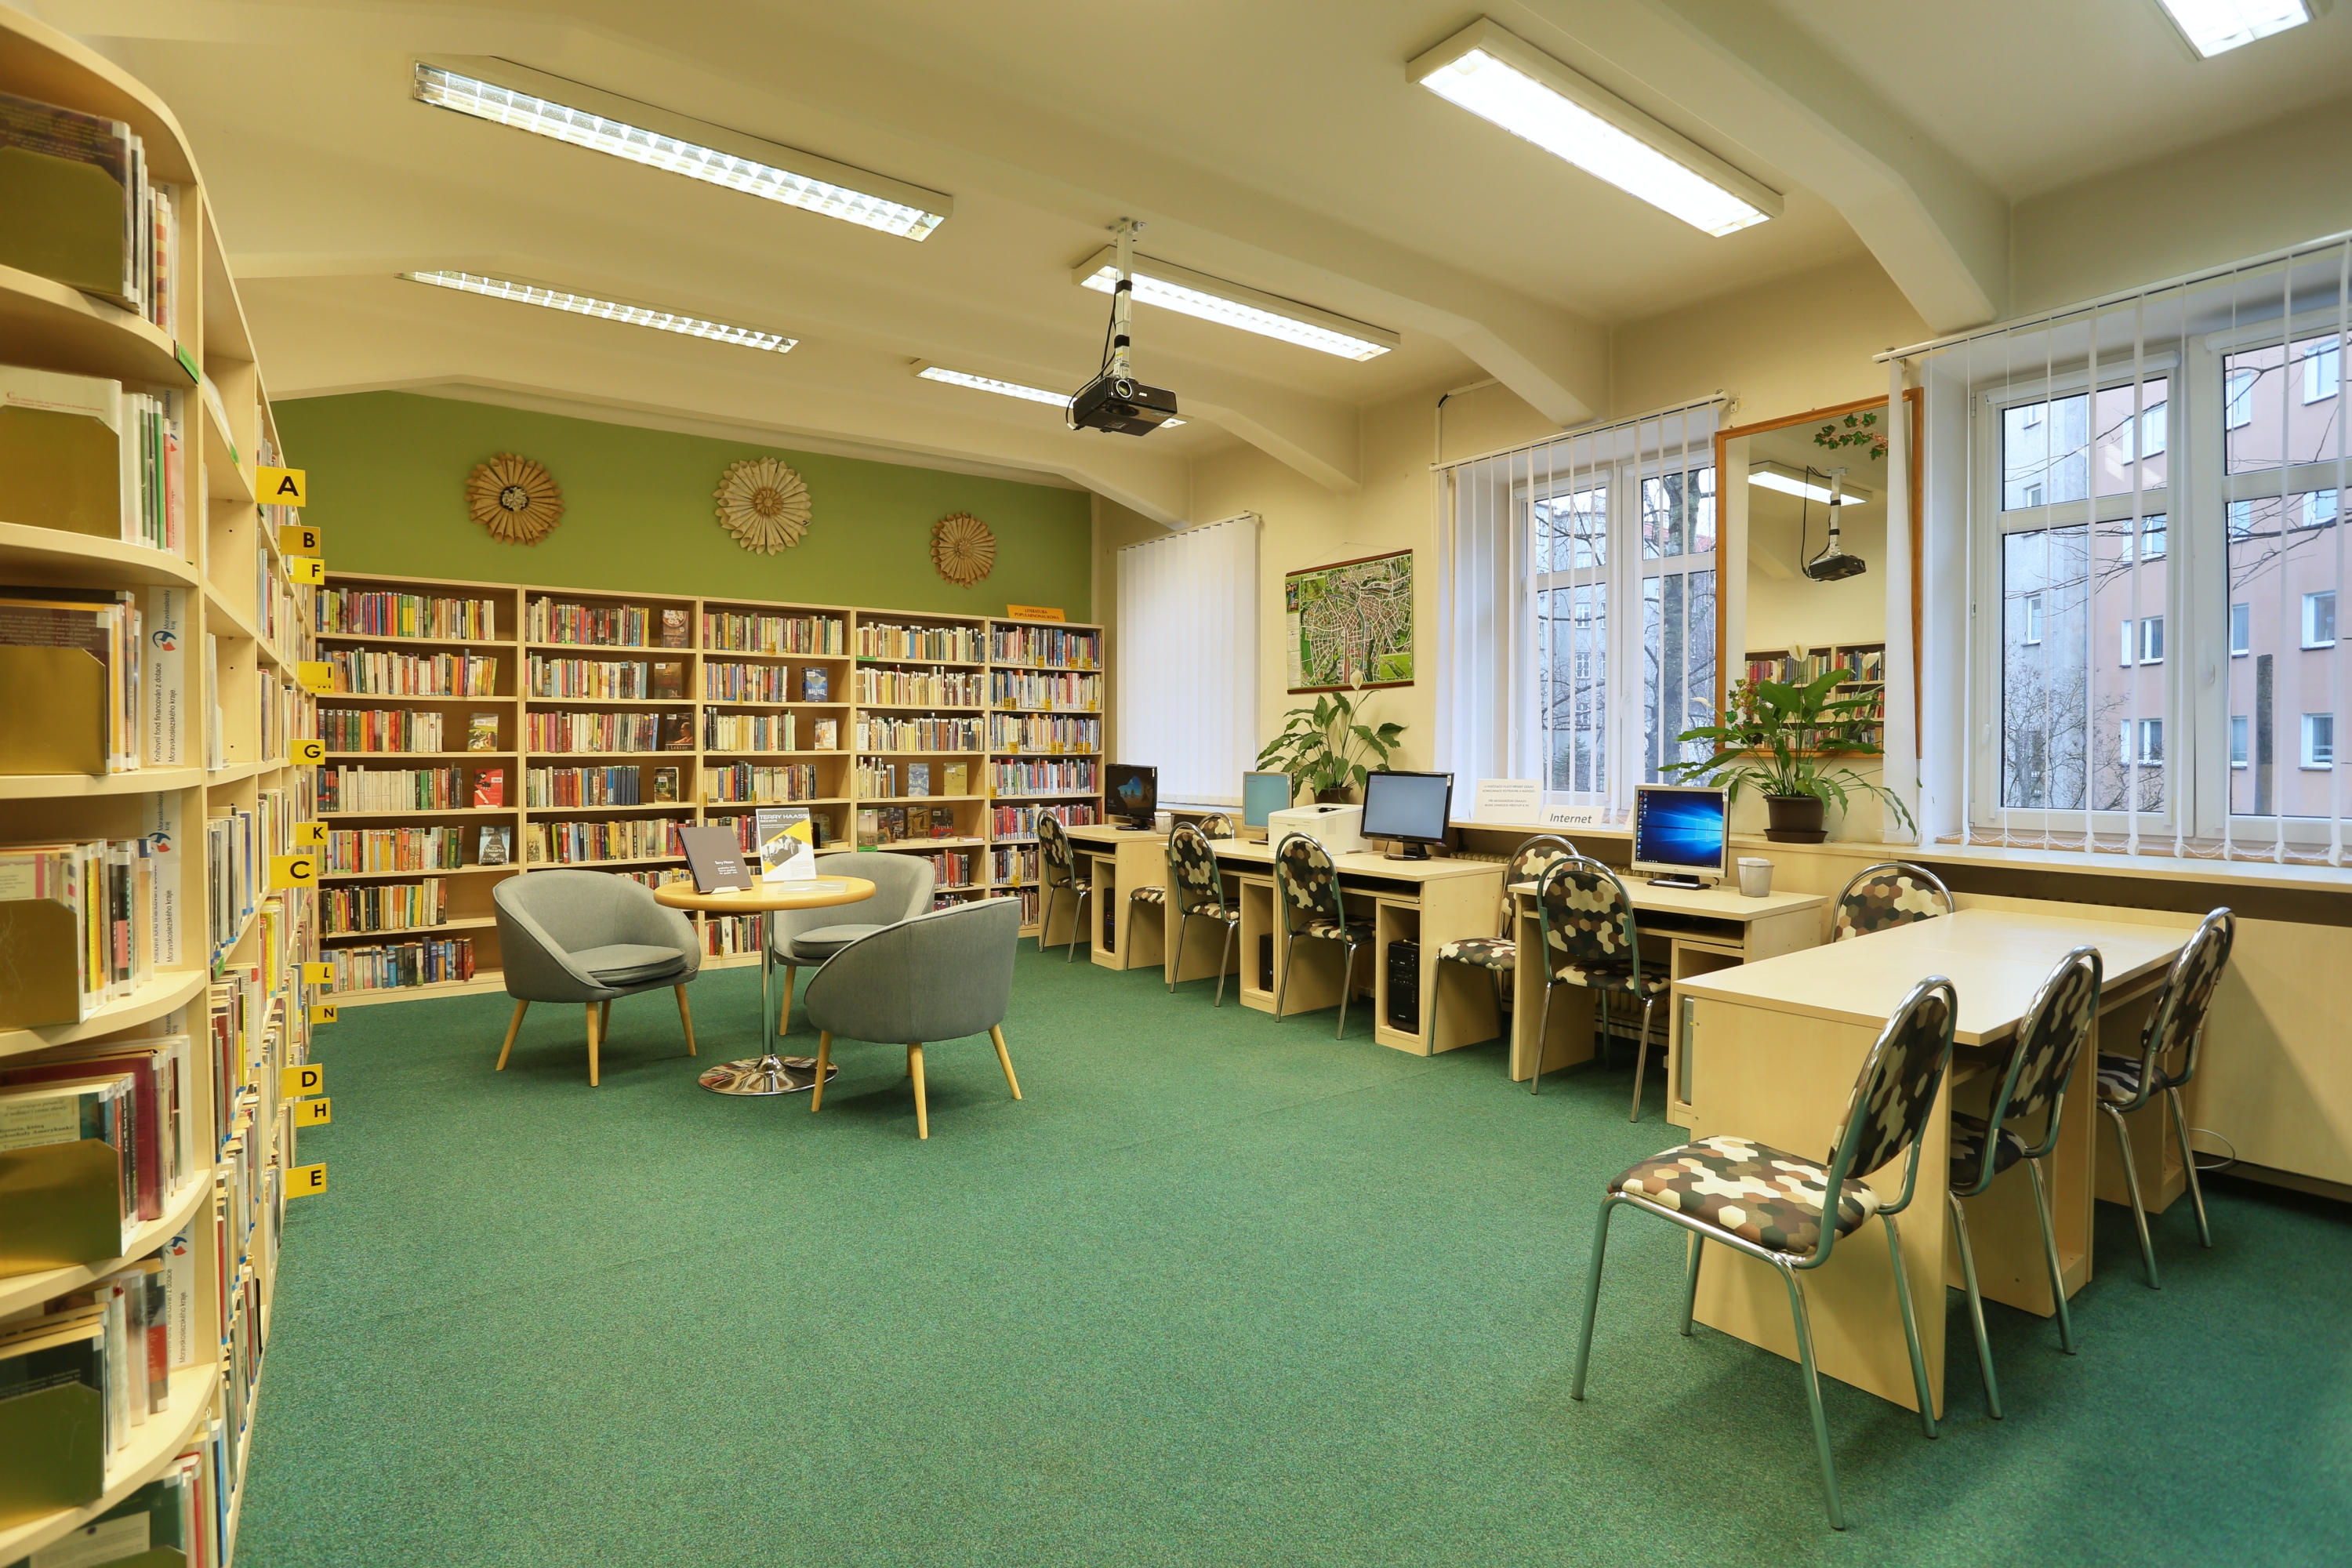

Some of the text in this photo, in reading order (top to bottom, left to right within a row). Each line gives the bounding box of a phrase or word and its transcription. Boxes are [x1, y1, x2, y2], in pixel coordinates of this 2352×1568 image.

[277, 475, 299, 497] A
[303, 532, 316, 548] B
[312, 564, 321, 578] F
[328, 666, 332, 679] I
[168, 688, 176, 704] kraje.
[304, 744, 321, 759] G
[1549, 813, 1592, 823] Internet
[313, 826, 324, 840] K
[290, 860, 310, 880] C
[165, 887, 173, 904] kraje.
[323, 967, 331, 978] L
[324, 1007, 334, 1018] N
[301, 1070, 318, 1087] D
[314, 1104, 327, 1118] H
[310, 1169, 322, 1187] E
[179, 1290, 187, 1307] kraje.
